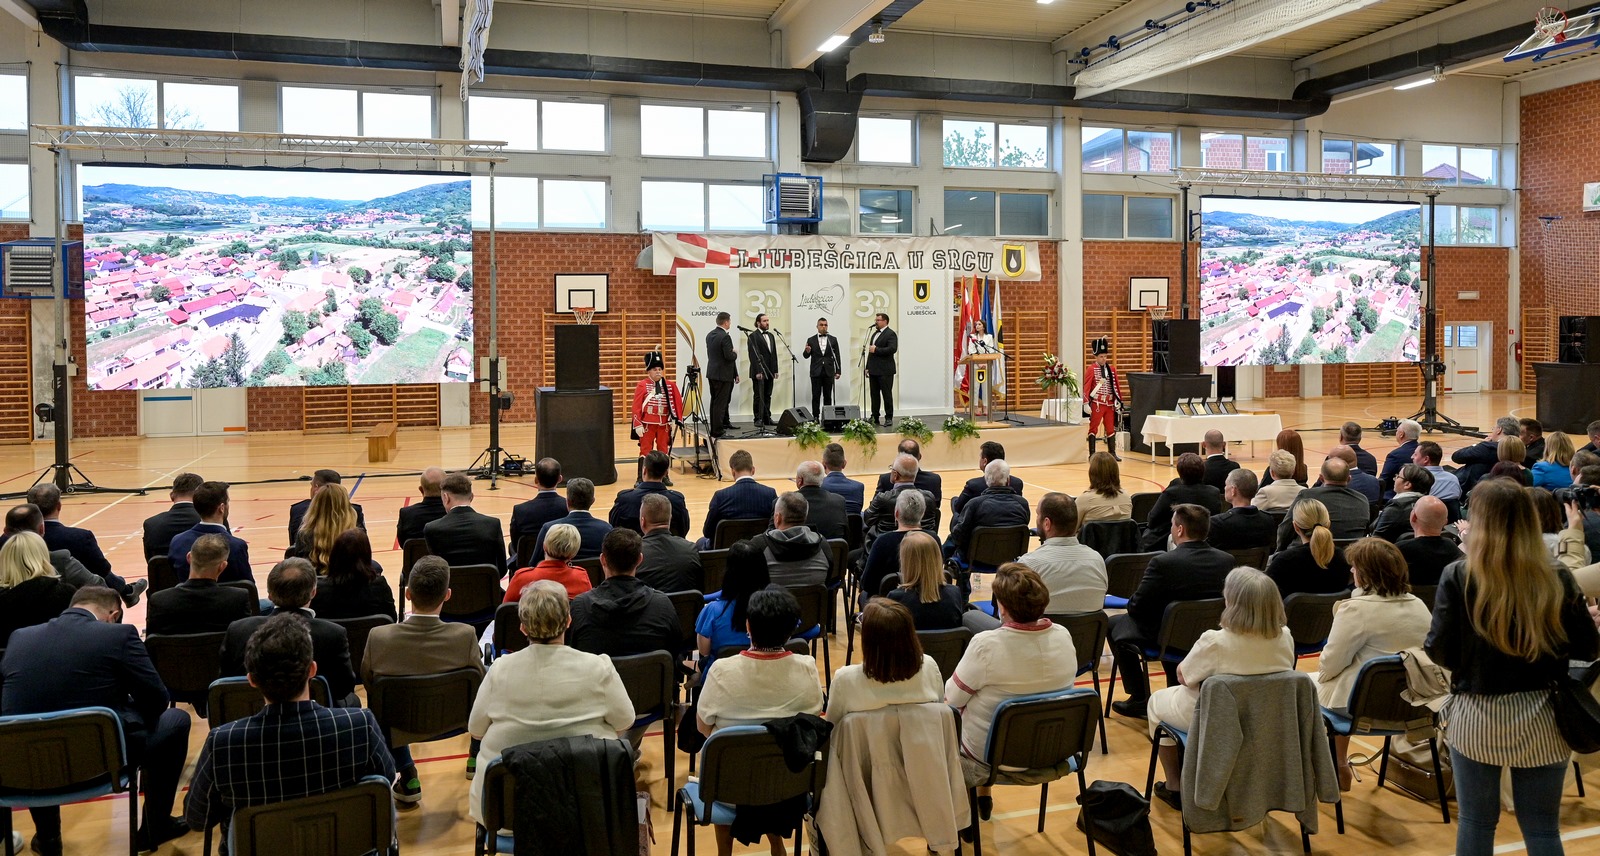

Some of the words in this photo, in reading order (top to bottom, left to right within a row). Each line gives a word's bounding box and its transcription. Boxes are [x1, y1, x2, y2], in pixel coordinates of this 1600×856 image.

[737, 243, 900, 270] LJUBEŠĆICA
[908, 250, 924, 270] U
[932, 249, 994, 273] SRCU
[745, 289, 782, 319] 30
[855, 289, 890, 318] 30
